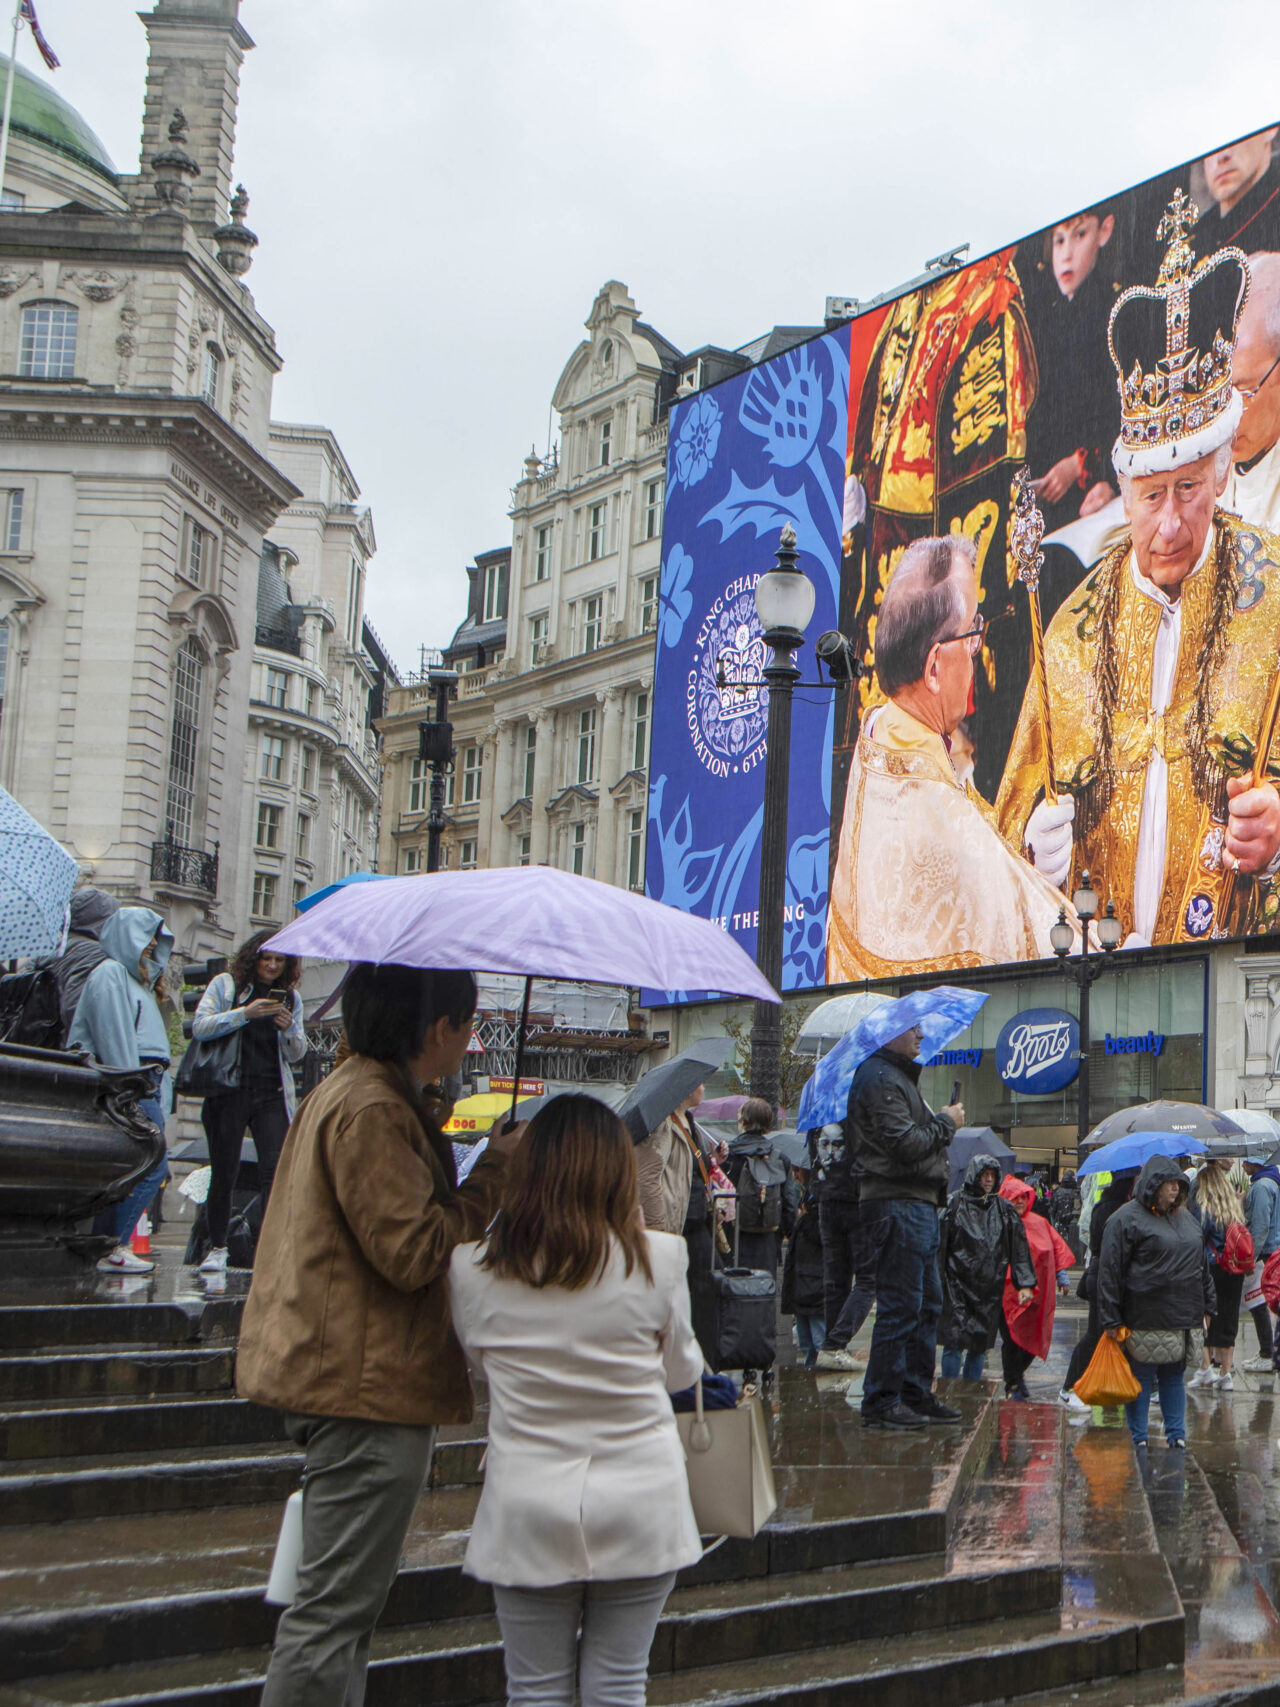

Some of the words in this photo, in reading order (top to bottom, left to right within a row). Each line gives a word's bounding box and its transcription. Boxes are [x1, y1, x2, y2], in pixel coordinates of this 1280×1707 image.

[696, 597, 724, 650] KING
[725, 573, 761, 601] CHAR
[687, 669, 731, 779] CORONATION
[742, 739, 768, 774] 6TH
[733, 910, 760, 931] THE
[1001, 1020, 1071, 1080] Boots
[1104, 1030, 1165, 1057] beauty
[489, 1080, 501, 1088] BUY
[523, 1083, 537, 1091] HERE
[453, 1119, 476, 1130] DOG
